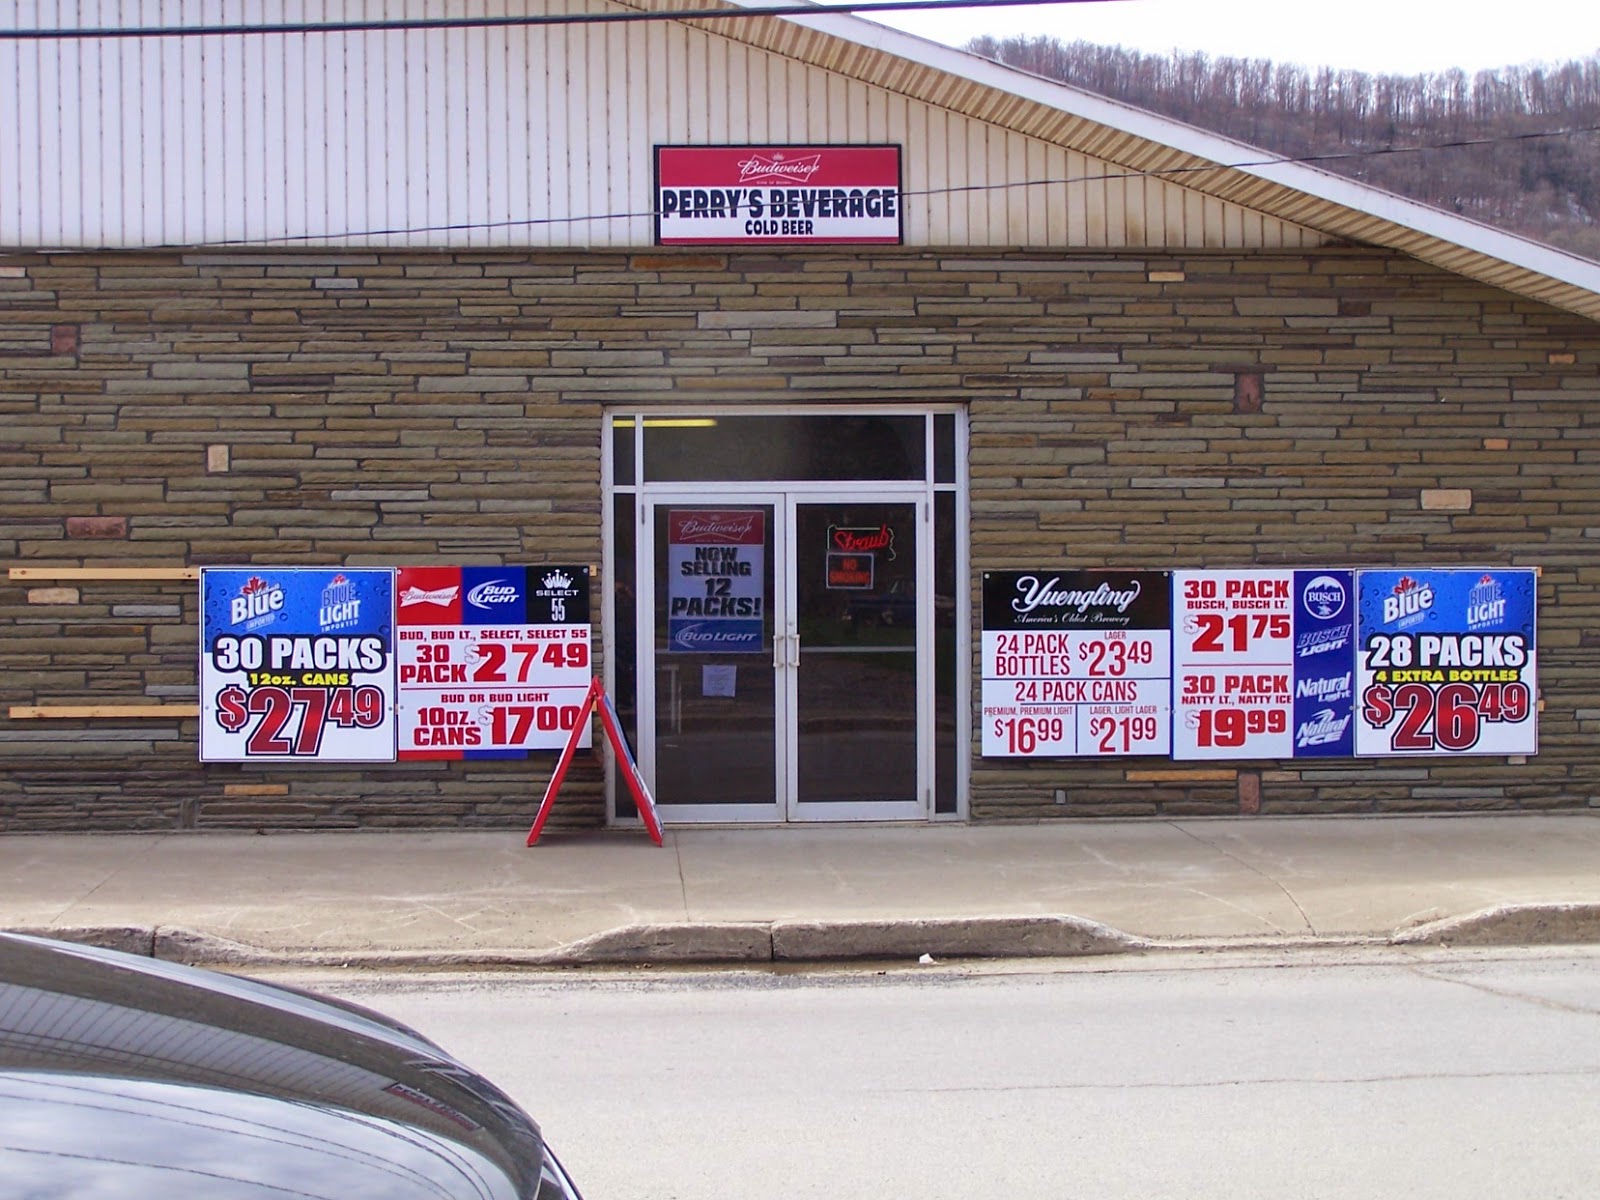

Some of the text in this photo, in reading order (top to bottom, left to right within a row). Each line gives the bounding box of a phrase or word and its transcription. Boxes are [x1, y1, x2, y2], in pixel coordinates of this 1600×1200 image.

[738, 161, 819, 174] Budweiser
[663, 189, 896, 218] PERRY'S BEVERAGE
[745, 221, 813, 235] COLD BEER
[679, 521, 752, 533] Budweiser
[695, 548, 737, 560] NOW
[682, 562, 751, 576] SELLING
[843, 558, 857, 570] NO
[322, 582, 356, 609] BLUE
[399, 590, 459, 602] Budweiser
[705, 578, 732, 596] 12
[1012, 576, 1140, 613] Yuengling
[1185, 581, 1289, 598] 30 PACK
[1470, 583, 1501, 608] BLUE
[476, 594, 519, 603] LIGHT
[1187, 600, 1287, 610] BUSCH, BUSCH LT.
[1308, 592, 1341, 602] BUSCH
[231, 590, 284, 625] Blue
[320, 600, 361, 626] LIGHT
[552, 599, 564, 621] 55
[671, 598, 760, 616] PACKS!
[1384, 590, 1432, 624] Blue
[1468, 600, 1506, 624] LIGHT
[1014, 613, 1130, 626] America's Oldest Brewery
[400, 631, 426, 641] BUD,
[431, 631, 454, 639] BUD
[481, 630, 523, 640] SELECT,
[527, 630, 566, 638] SELECT
[572, 630, 587, 638] 55
[684, 633, 756, 641] BUD LIGHT
[997, 634, 1069, 654] 24 PACK
[1296, 624, 1352, 648] BUSCH
[217, 638, 382, 669] 30 PACKS
[417, 644, 449, 663] 30
[1300, 638, 1346, 657] LIGHT
[1370, 636, 1524, 666] 28 PACKS
[401, 665, 467, 683] PACK
[996, 656, 1070, 676] BOTTLES
[250, 674, 349, 685] 12oz. CANS
[1184, 676, 1288, 693] 30 PACK
[1296, 671, 1351, 699] Natural
[1376, 671, 1518, 681] 4 EXTRA BOTTLES
[442, 693, 549, 702] BUD OR BUD LIGHT
[1016, 681, 1137, 701] 24 PACK CANS
[1182, 696, 1215, 704] NATTY
[1239, 696, 1272, 704] NATTY
[1276, 695, 1292, 703] ICE
[984, 707, 1018, 715] PREMIUM,
[1090, 706, 1157, 715] LAGER, LIGHT LAGER
[414, 727, 481, 745] CANS
[1296, 715, 1350, 739] Natural
[1298, 731, 1343, 747] ICE
